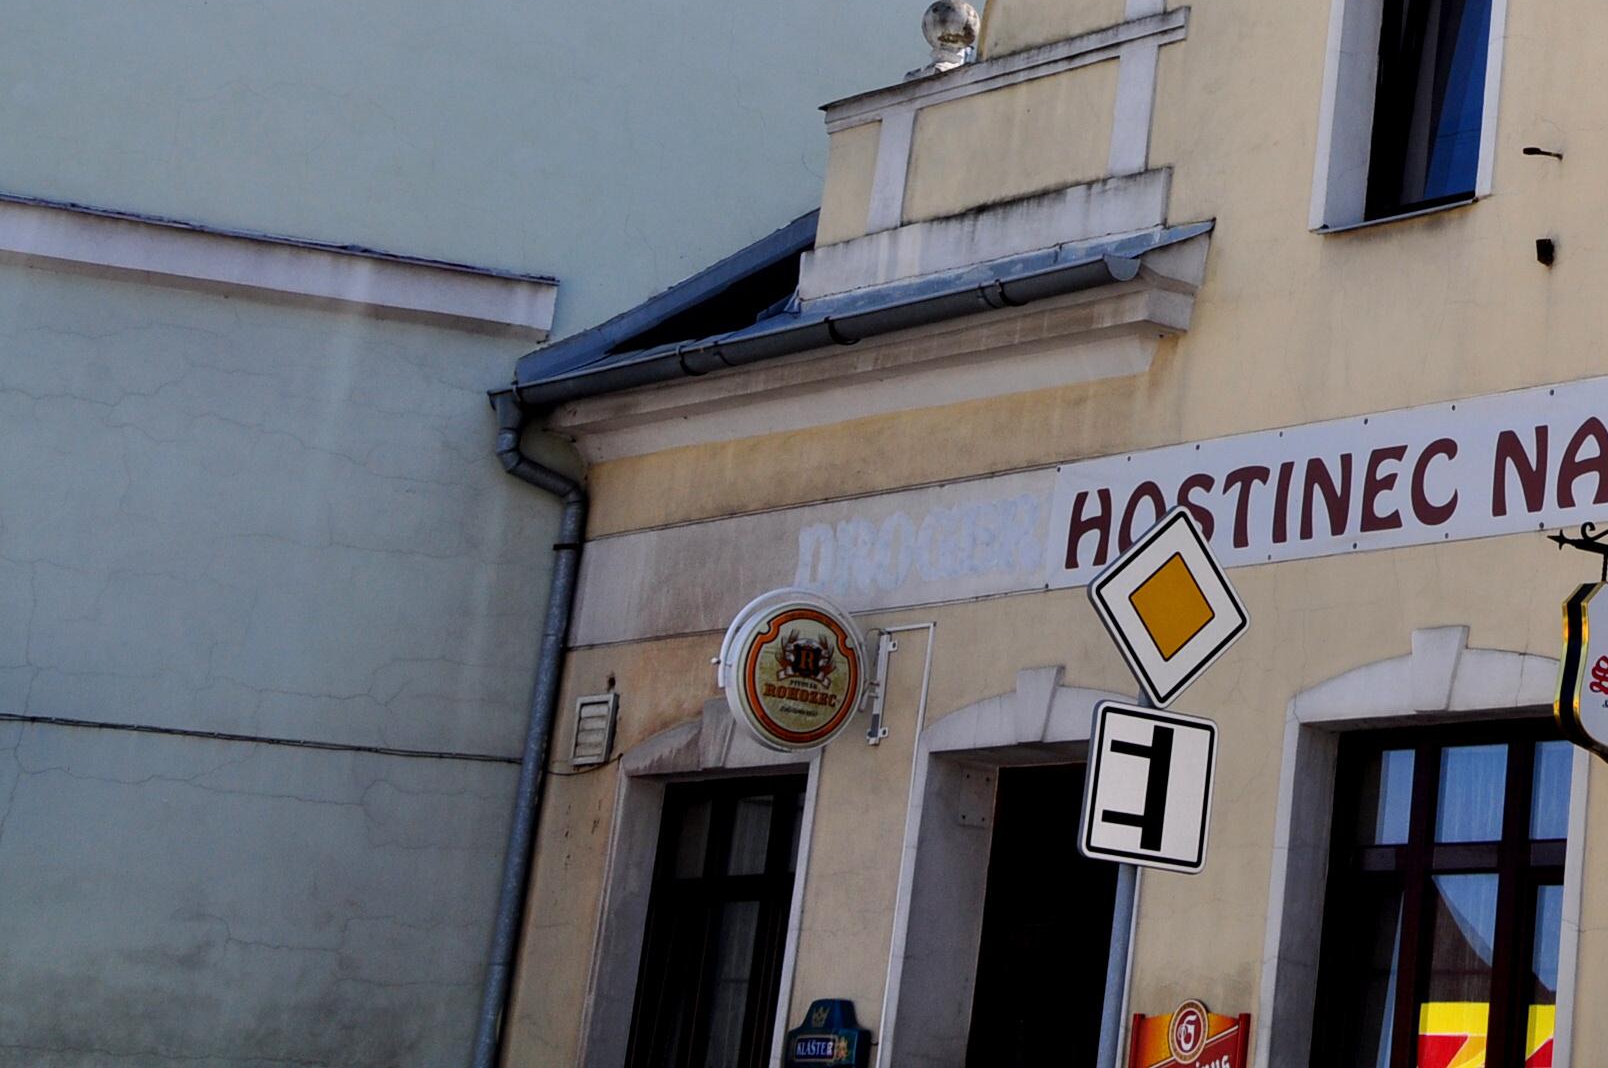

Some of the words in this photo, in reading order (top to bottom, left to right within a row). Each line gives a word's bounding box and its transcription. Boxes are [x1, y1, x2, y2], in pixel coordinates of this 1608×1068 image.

[1064, 436, 1459, 569] HOSTINEC
[762, 682, 838, 708] ROHOZEC
[796, 1039, 834, 1056] KLÁŠTER
